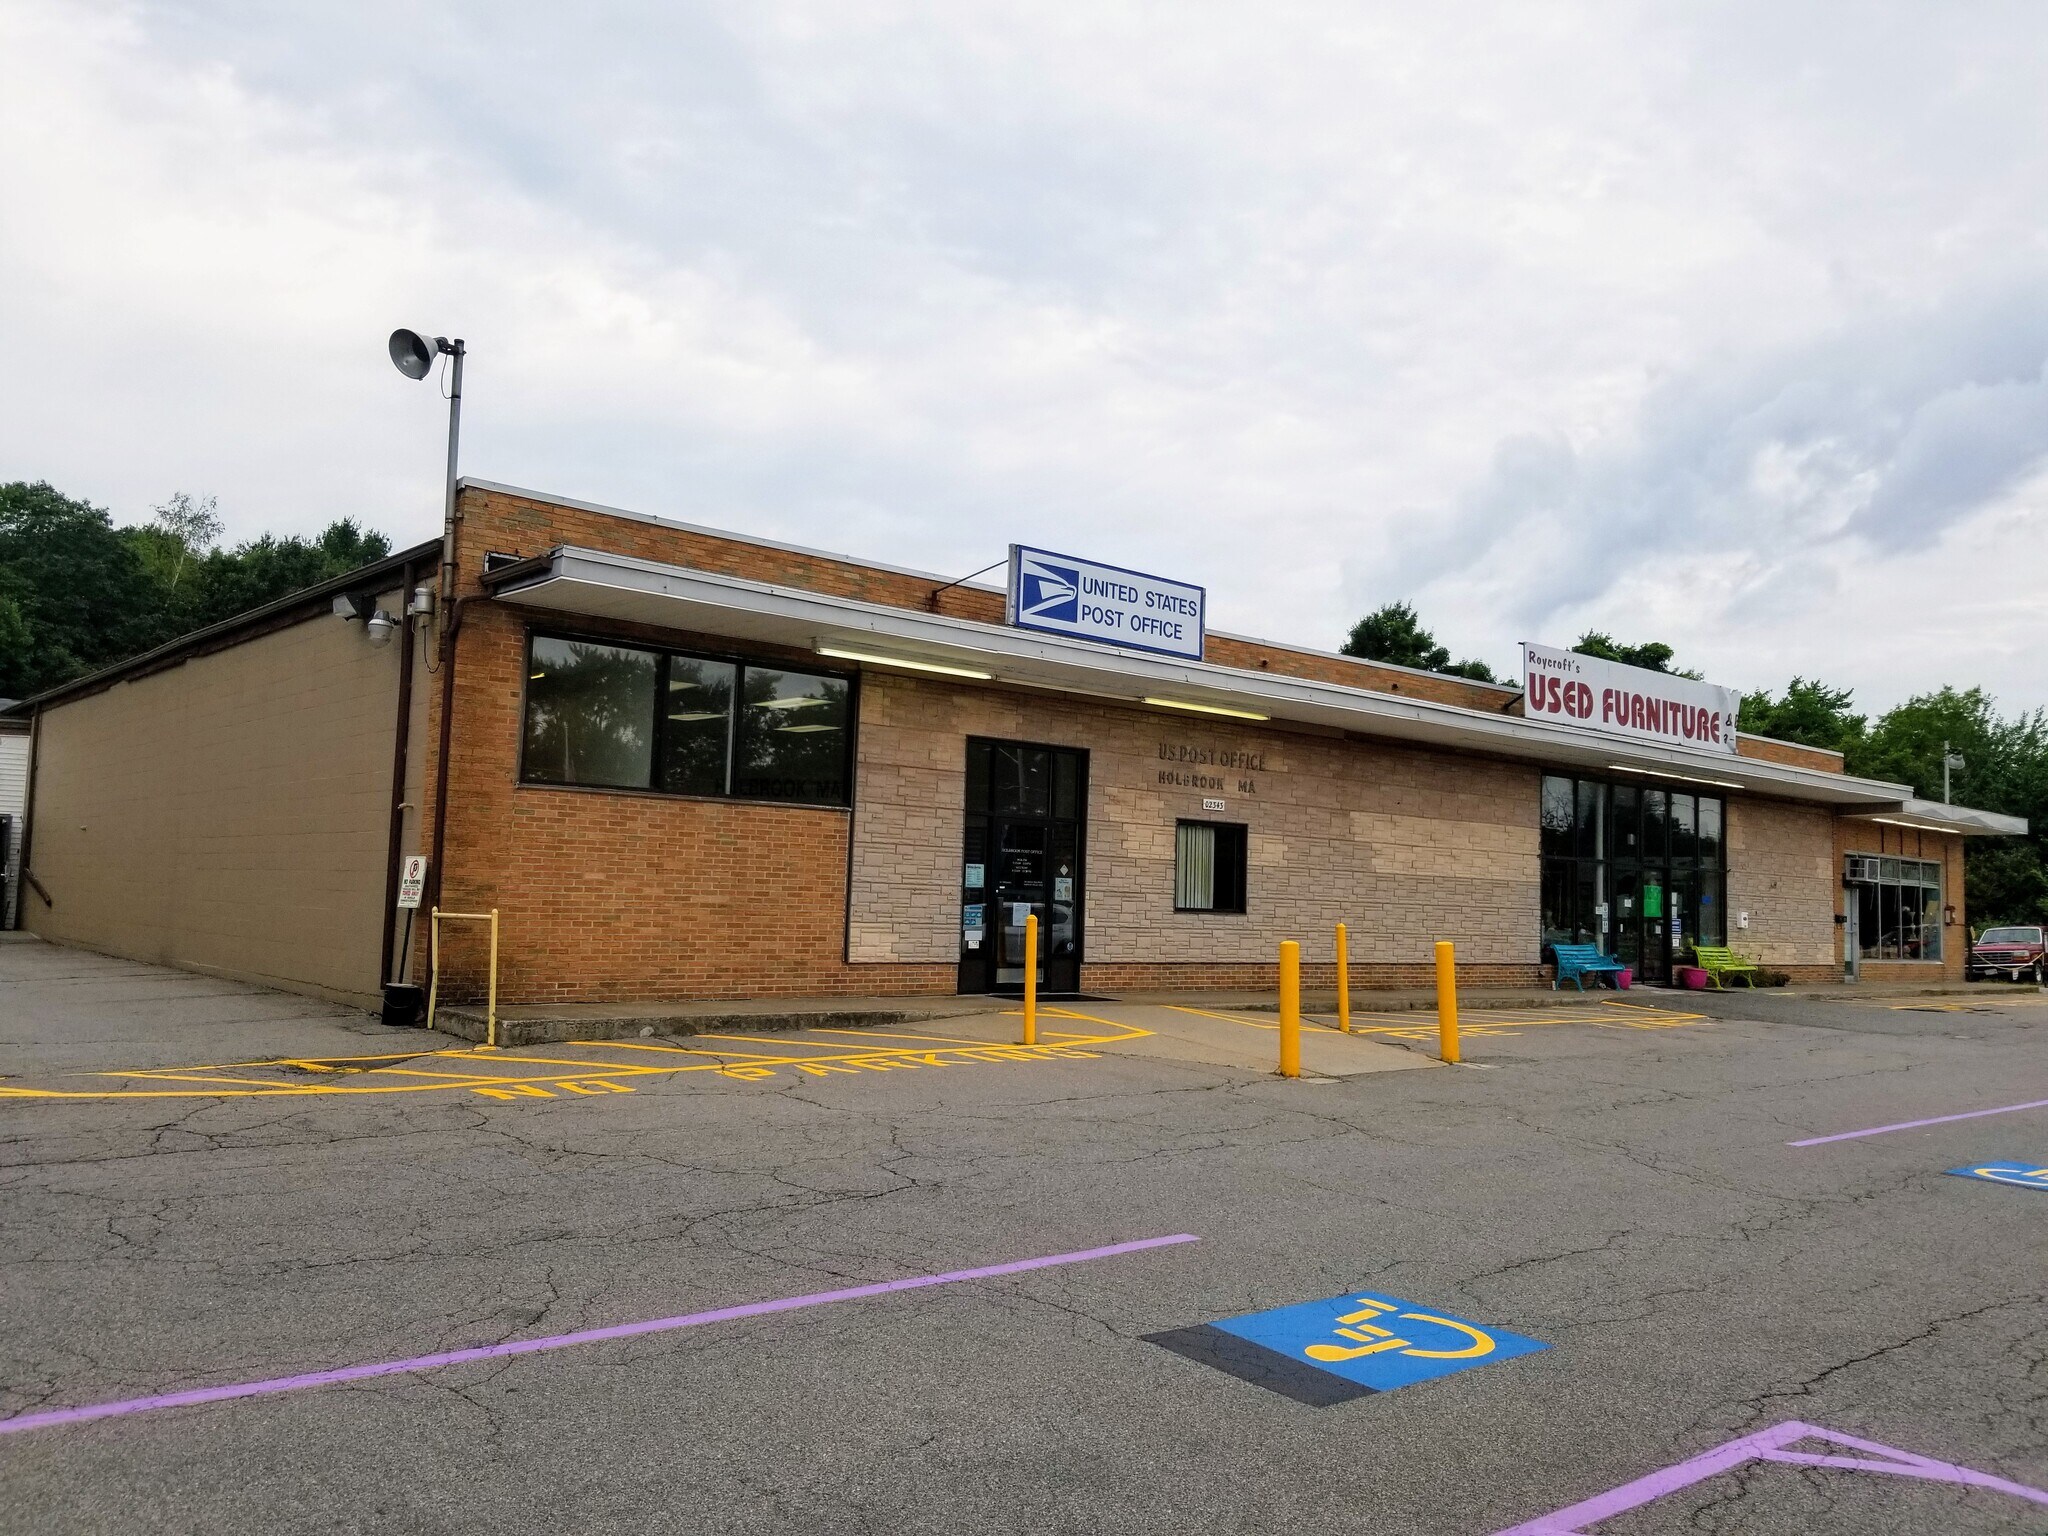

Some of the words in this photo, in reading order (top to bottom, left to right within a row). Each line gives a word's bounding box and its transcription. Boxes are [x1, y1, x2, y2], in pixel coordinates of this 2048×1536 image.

[1082, 576, 1139, 604] UNITED
[1145, 590, 1198, 617] STATES
[1081, 604, 1125, 628] POST
[1130, 614, 1183, 640] OFFICE
[1528, 650, 1581, 674] Roycroft's
[1528, 672, 1594, 720] USED
[1602, 688, 1720, 744] FURNITURE
[1179, 744, 1215, 766] POST
[1220, 751, 1267, 772] OFFICE
[1158, 769, 1224, 791] HOLBROOK
[1237, 779, 1256, 794] MA
[469, 1084, 638, 1101] NO
[713, 1047, 1103, 1081] PARKING
